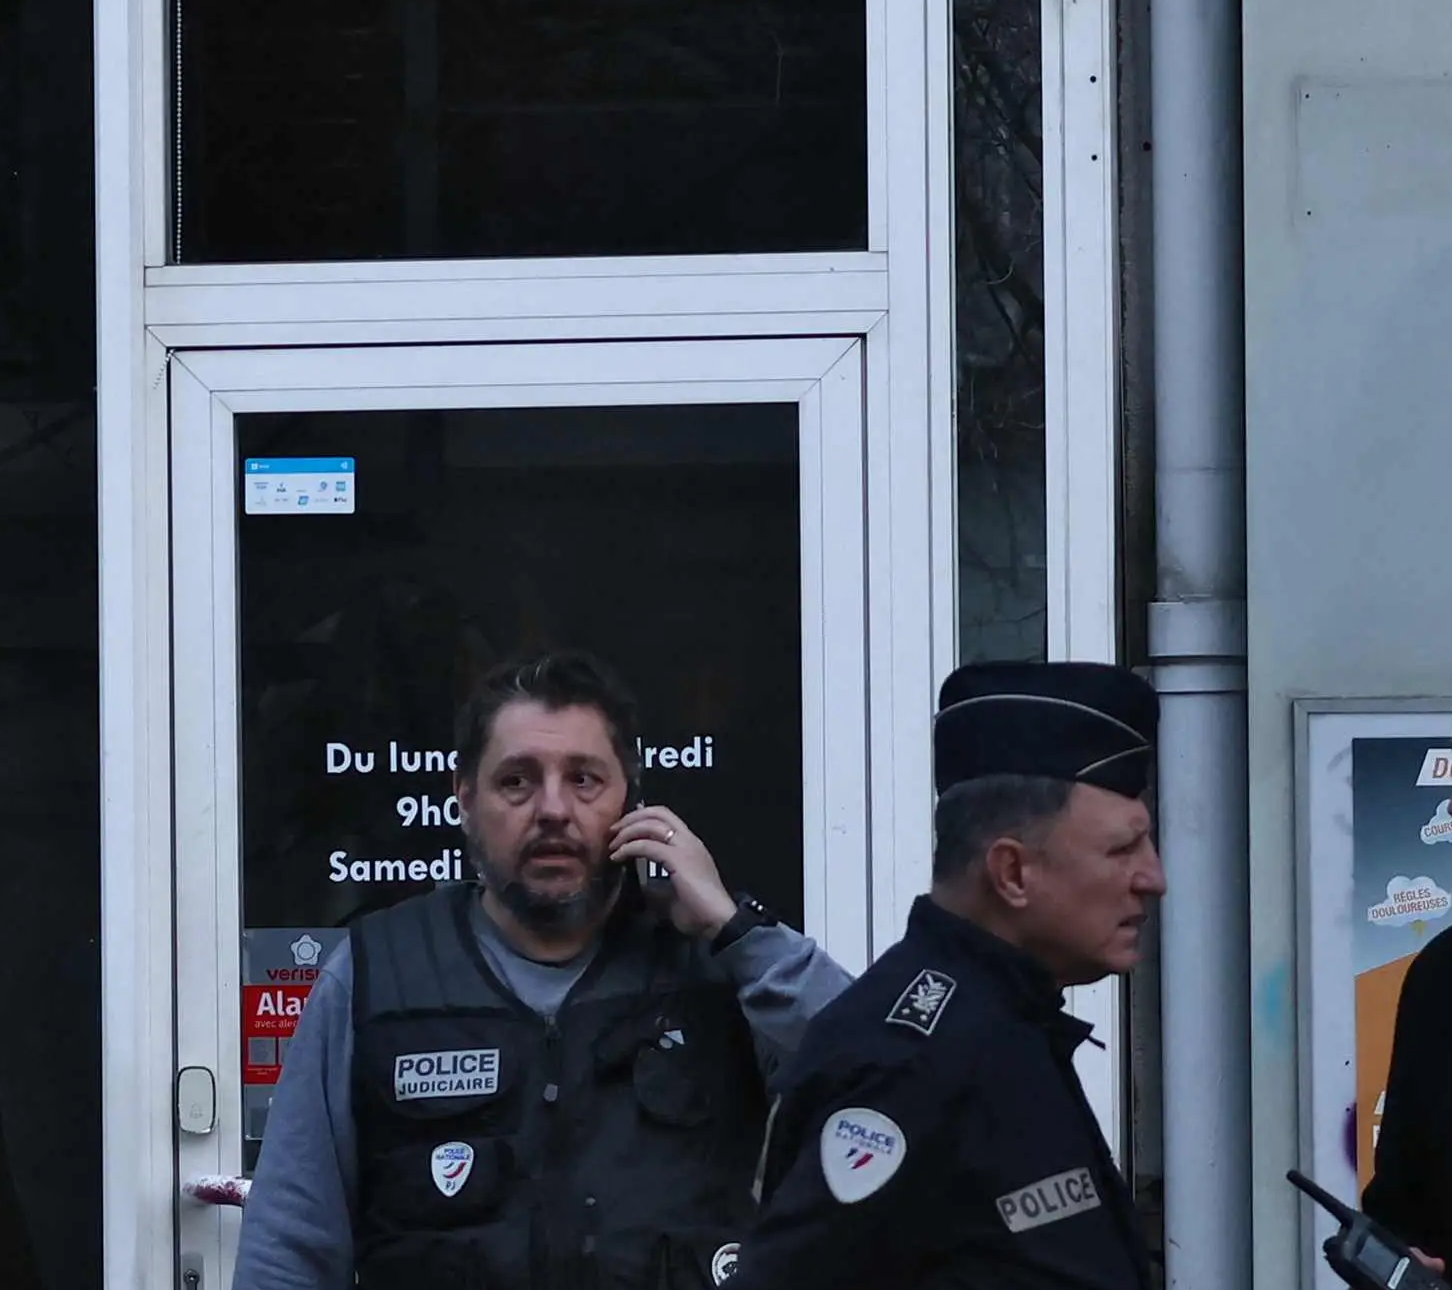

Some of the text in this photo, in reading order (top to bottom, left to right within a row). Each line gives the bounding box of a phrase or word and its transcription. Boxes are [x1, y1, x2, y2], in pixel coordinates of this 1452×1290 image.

[326, 743, 375, 774] Du
[636, 736, 714, 769] redi
[329, 849, 462, 882] Samedi
[398, 1053, 495, 1079] POLICE
[398, 1077, 495, 1096] JUDICIAIRE
[838, 1119, 896, 1147] POLICE
[998, 1172, 1095, 1225] POLICE
